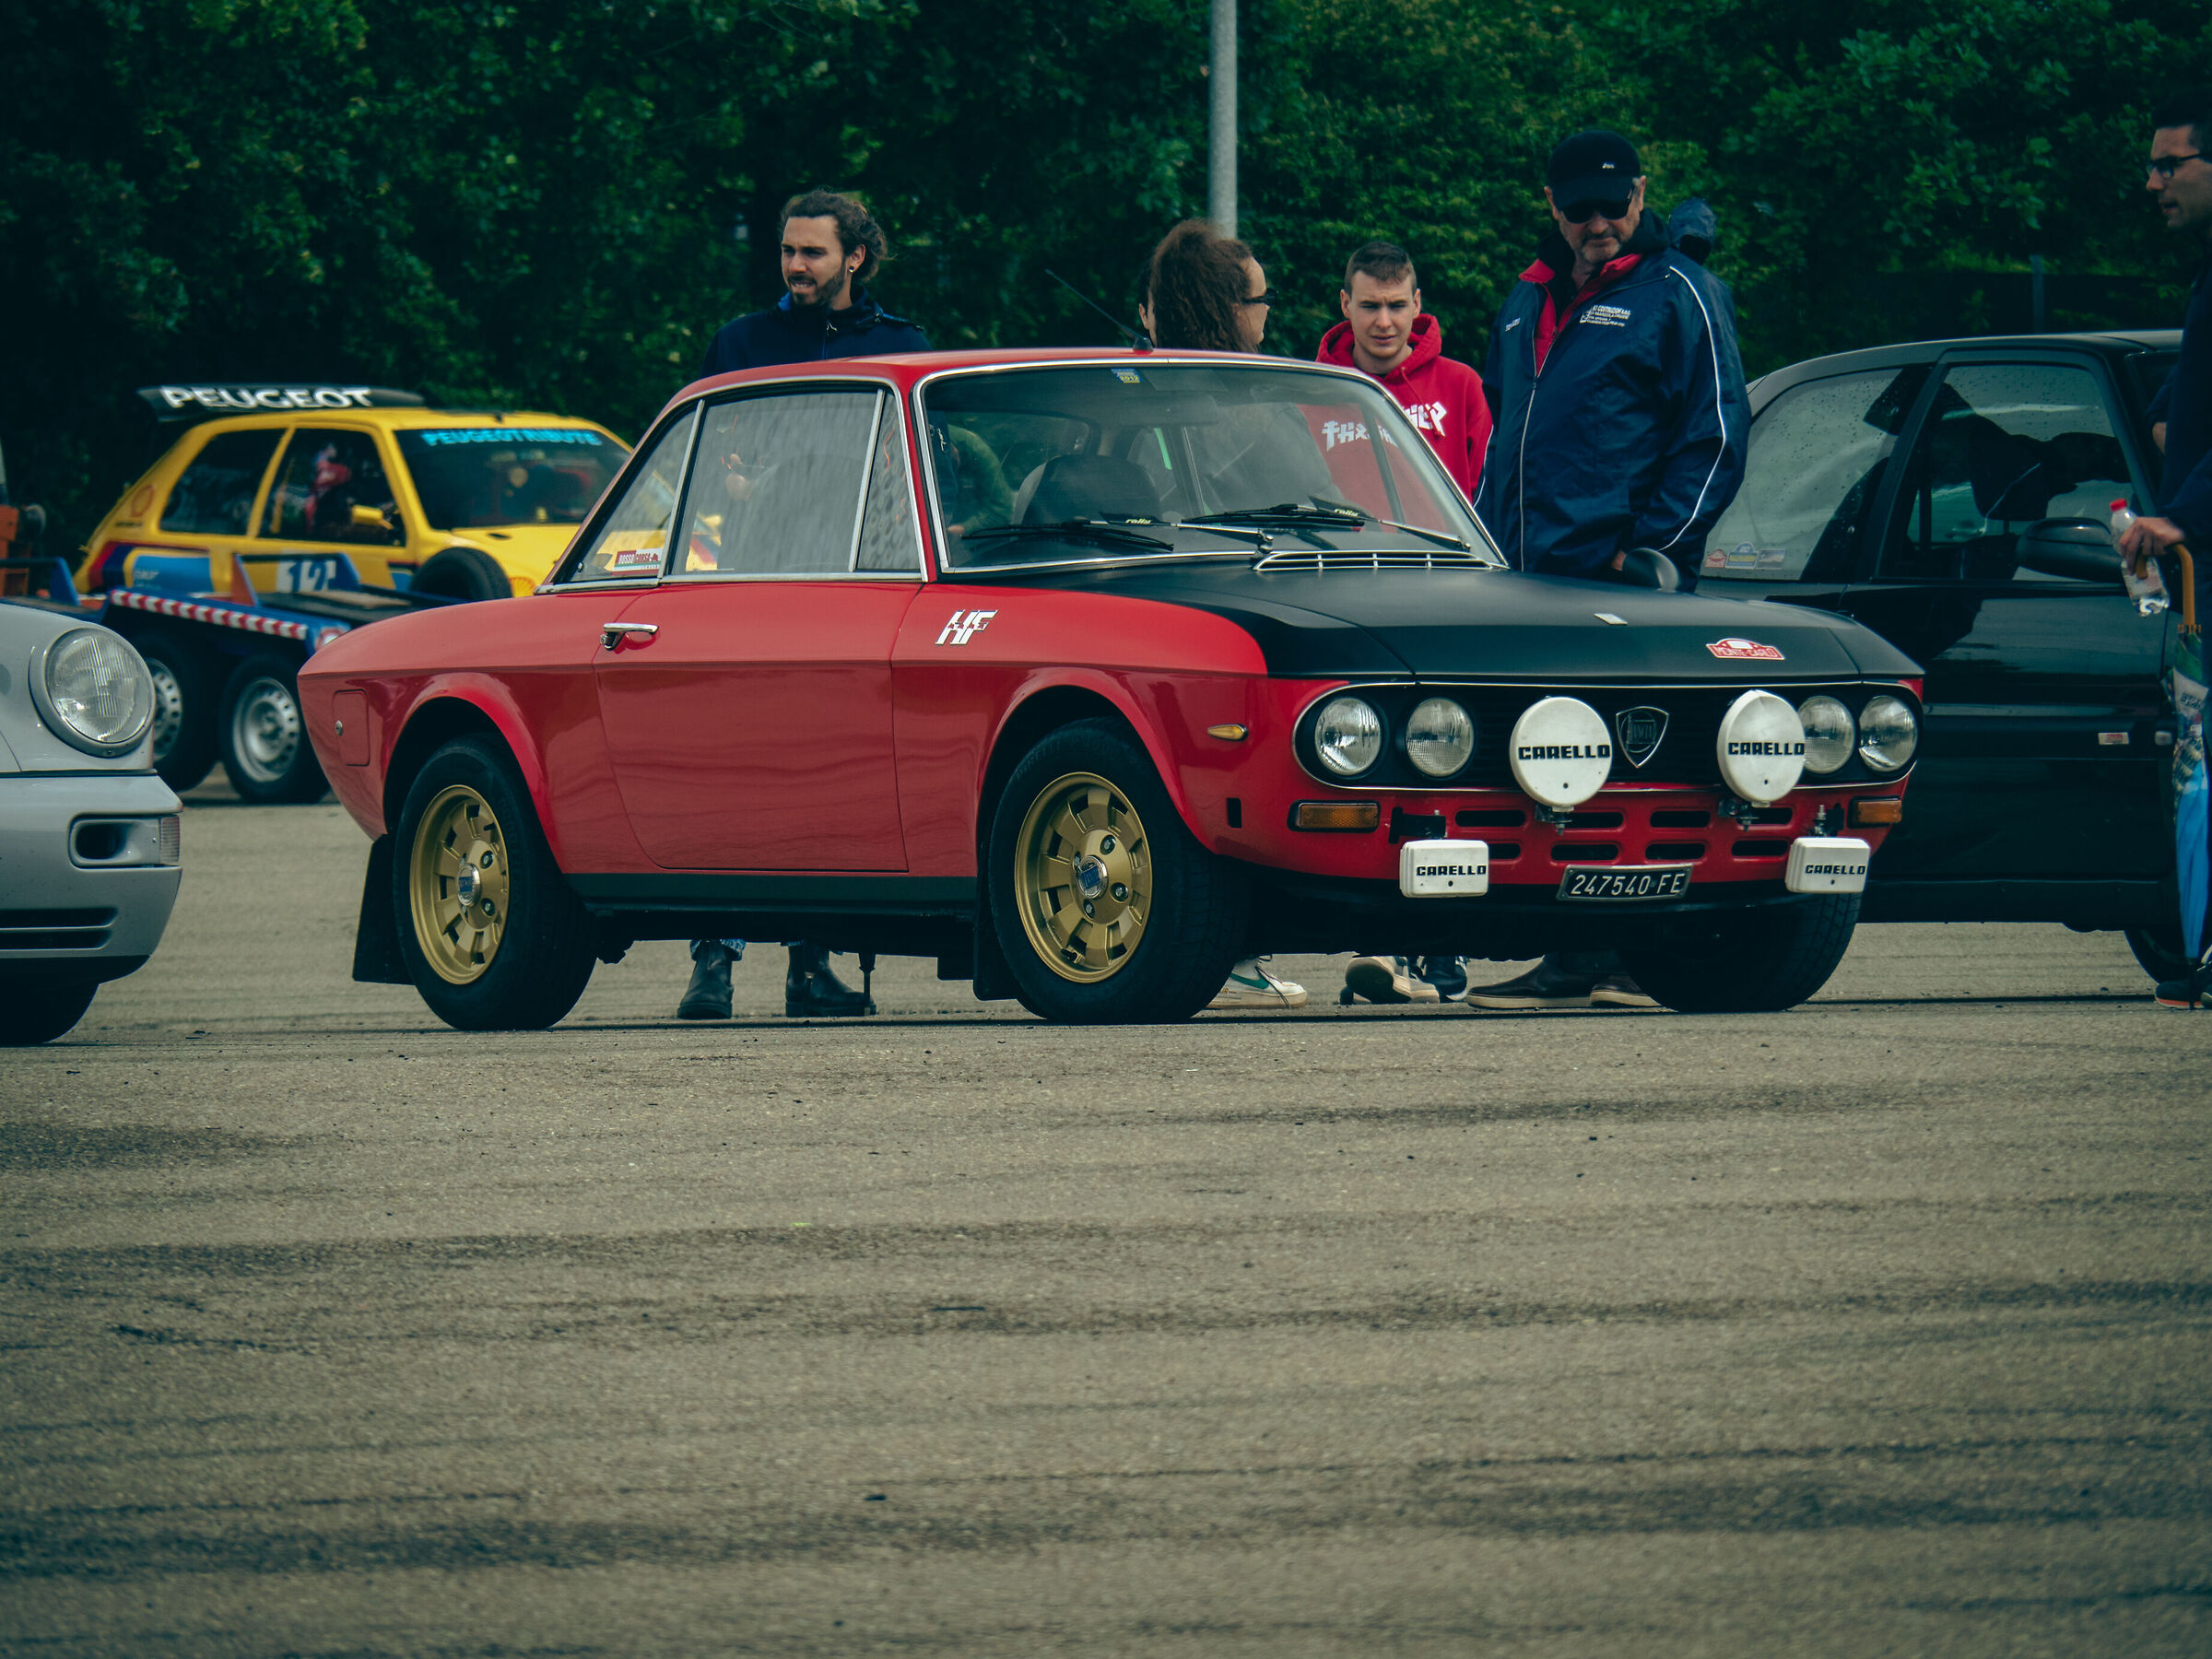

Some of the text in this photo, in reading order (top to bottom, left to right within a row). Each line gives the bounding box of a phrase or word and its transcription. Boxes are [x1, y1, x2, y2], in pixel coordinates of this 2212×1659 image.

[160, 385, 373, 408] PEUGEOT
[935, 609, 998, 645] HF
[1518, 744, 1611, 760] CARELLO
[1728, 742, 1806, 756] CARELLO
[1416, 865, 1487, 877] CARELLO
[1805, 865, 1866, 875] CARELLO
[1571, 873, 1685, 896] 247540 FE
